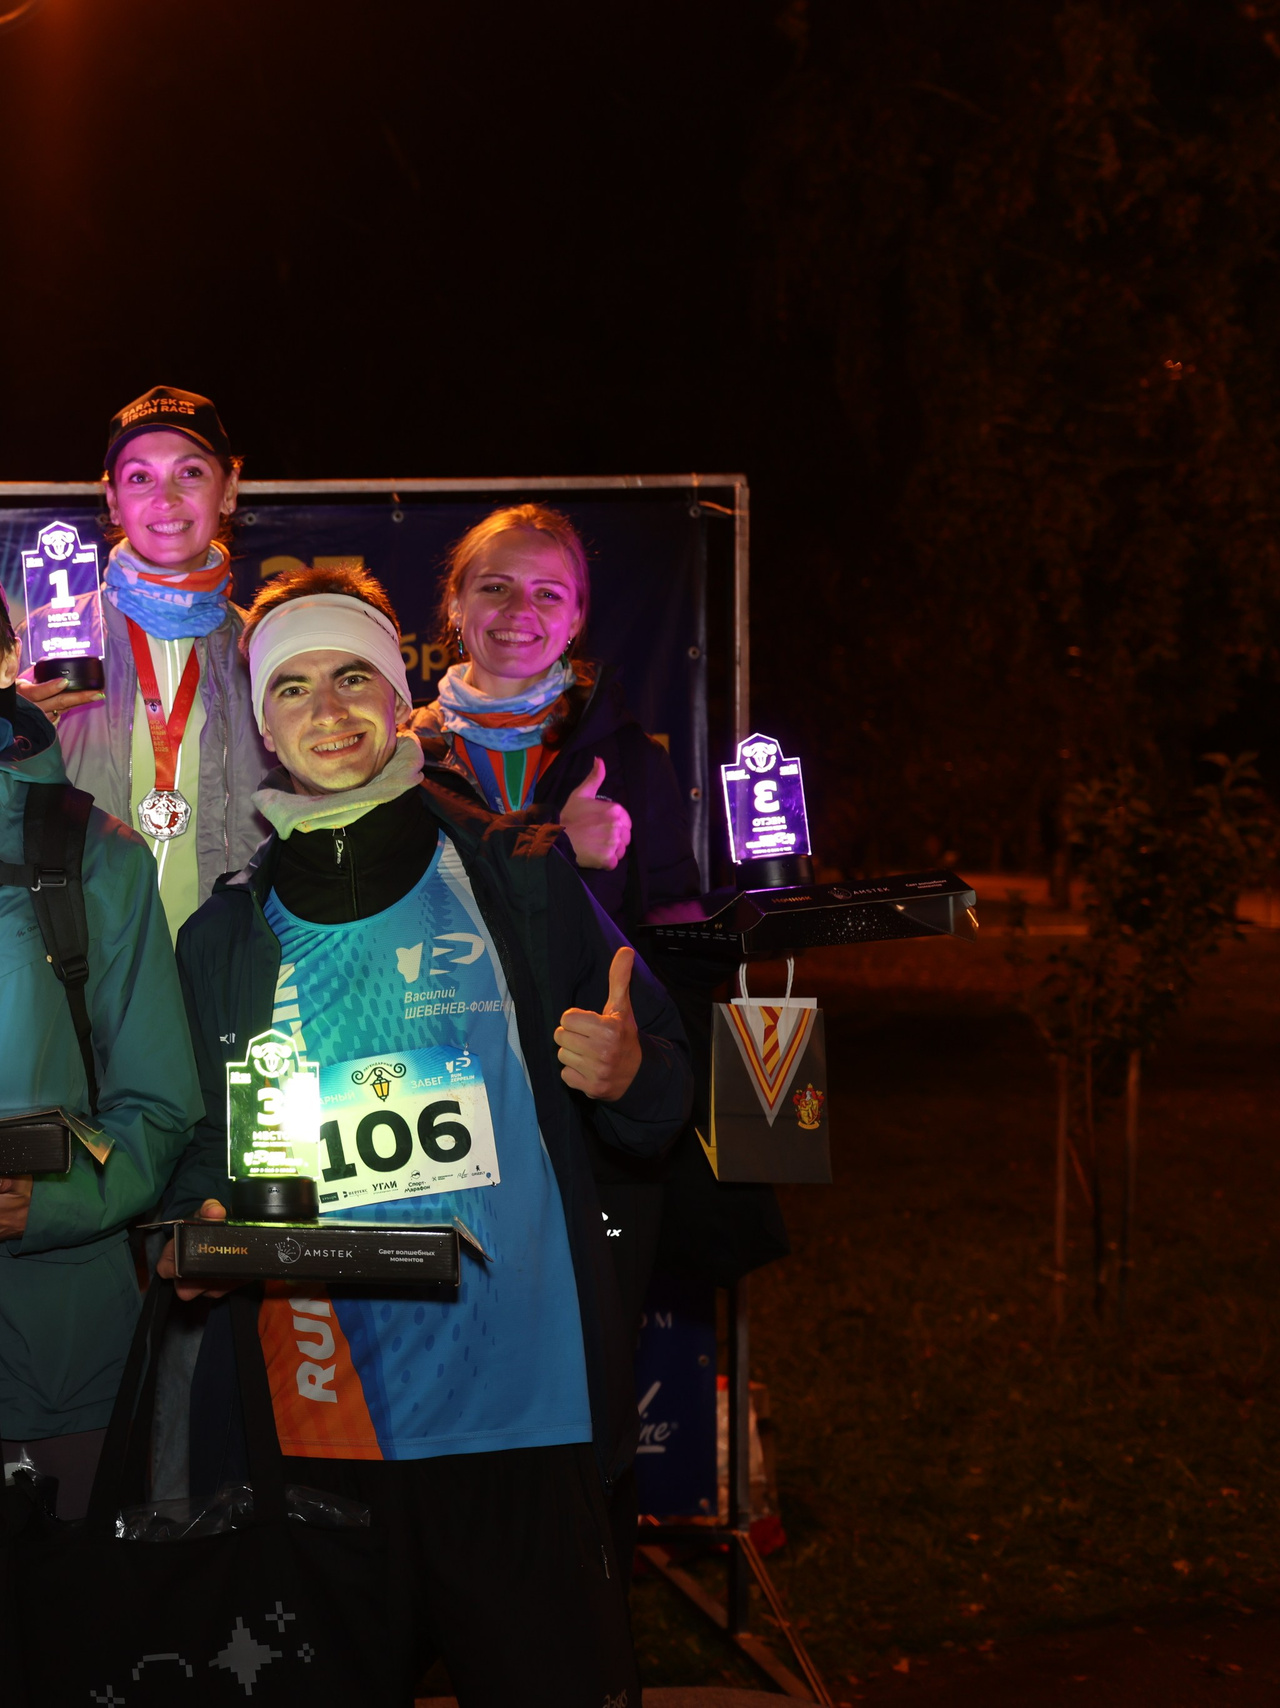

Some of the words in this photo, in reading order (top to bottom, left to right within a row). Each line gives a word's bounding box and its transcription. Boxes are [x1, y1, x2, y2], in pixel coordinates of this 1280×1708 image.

[121, 398, 177, 420] ZARAYSK
[122, 406, 158, 427] BISON
[160, 405, 195, 415] RACE
[49, 569, 76, 609] 1
[400, 632, 450, 682] бр
[404, 986, 456, 1004] Василий
[320, 1091, 356, 1105] АРНЫЙ
[411, 1076, 444, 1089] ЗАБЕГ
[257, 1087, 286, 1126] 3
[319, 1100, 472, 1183] 106
[403, 1184, 431, 1194] Марафон
[197, 1243, 249, 1256] Ночник
[304, 1249, 353, 1259] AMSTEK
[378, 1248, 395, 1256] Свет
[396, 1249, 435, 1257] волшебных
